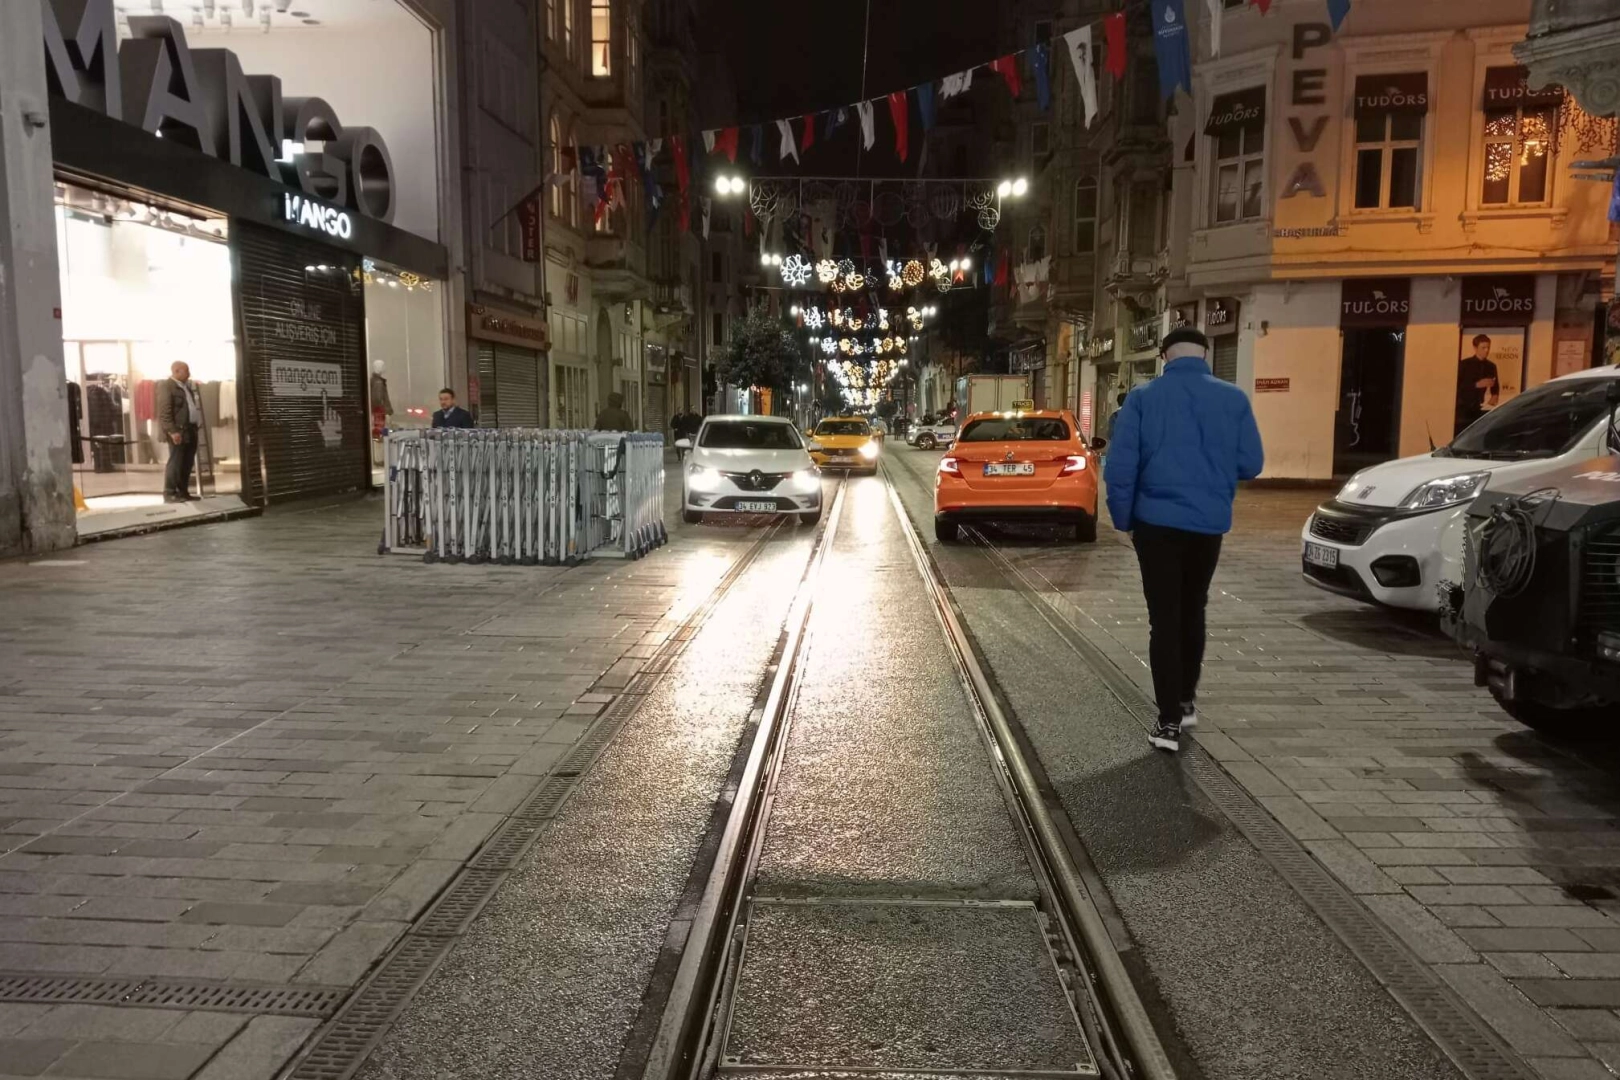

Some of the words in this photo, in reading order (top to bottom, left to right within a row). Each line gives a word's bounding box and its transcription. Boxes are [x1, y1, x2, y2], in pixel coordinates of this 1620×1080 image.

[1356, 93, 1427, 107] TUDORS
[42, 0, 396, 223] MANGO
[1208, 106, 1260, 126] TUDORS
[1281, 23, 1332, 198] PEVA
[284, 192, 351, 239] MANGO
[1343, 300, 1409, 314] TUDORS
[1465, 298, 1533, 313] TUDORS
[275, 366, 339, 392] mango.com
[989, 465, 998, 473] 34
[1003, 464, 1017, 473] TER
[1023, 464, 1033, 473] 45
[739, 502, 747, 510] 34
